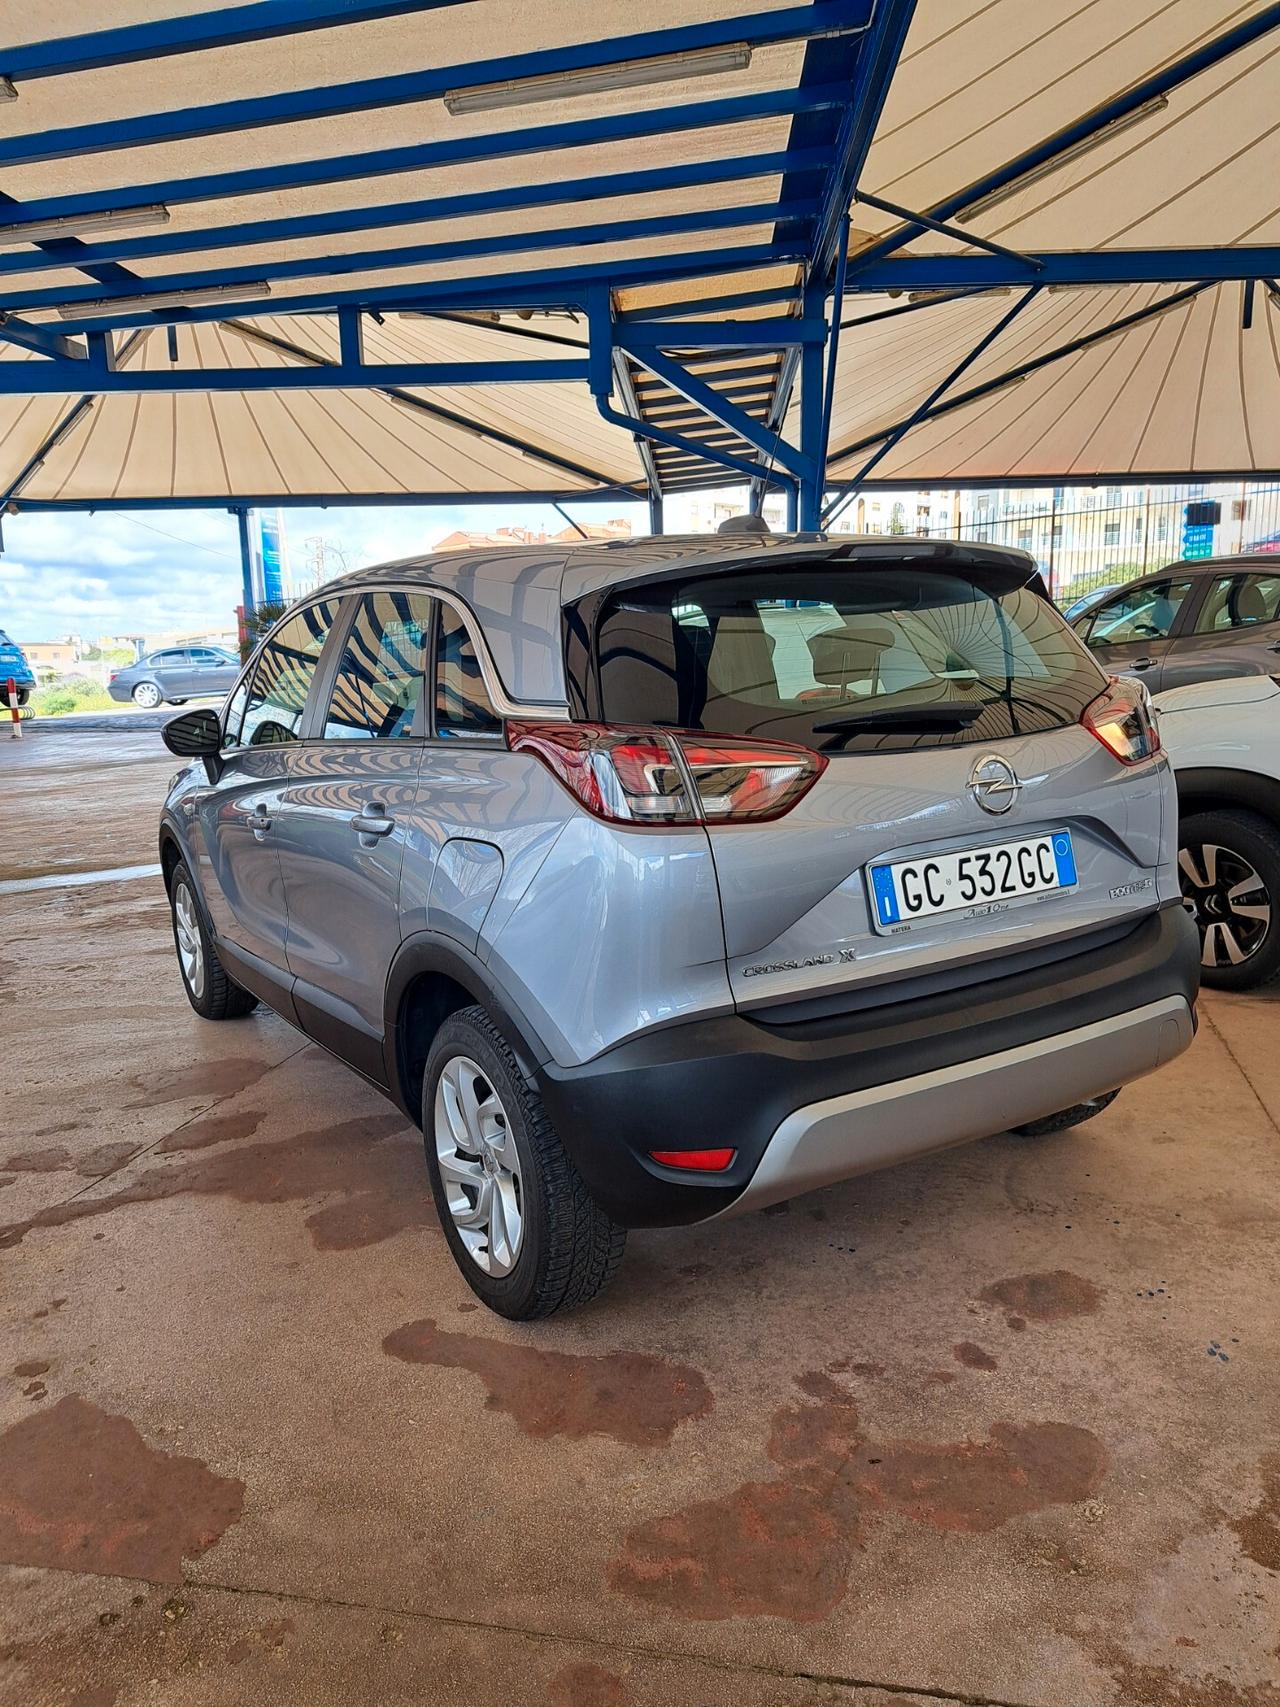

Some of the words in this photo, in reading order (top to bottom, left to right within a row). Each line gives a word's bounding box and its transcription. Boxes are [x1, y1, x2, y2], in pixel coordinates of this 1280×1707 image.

[901, 863, 945, 912] GC
[958, 843, 1055, 901] 532GC
[742, 954, 834, 977] CROSSLAND
[838, 948, 857, 964] X
